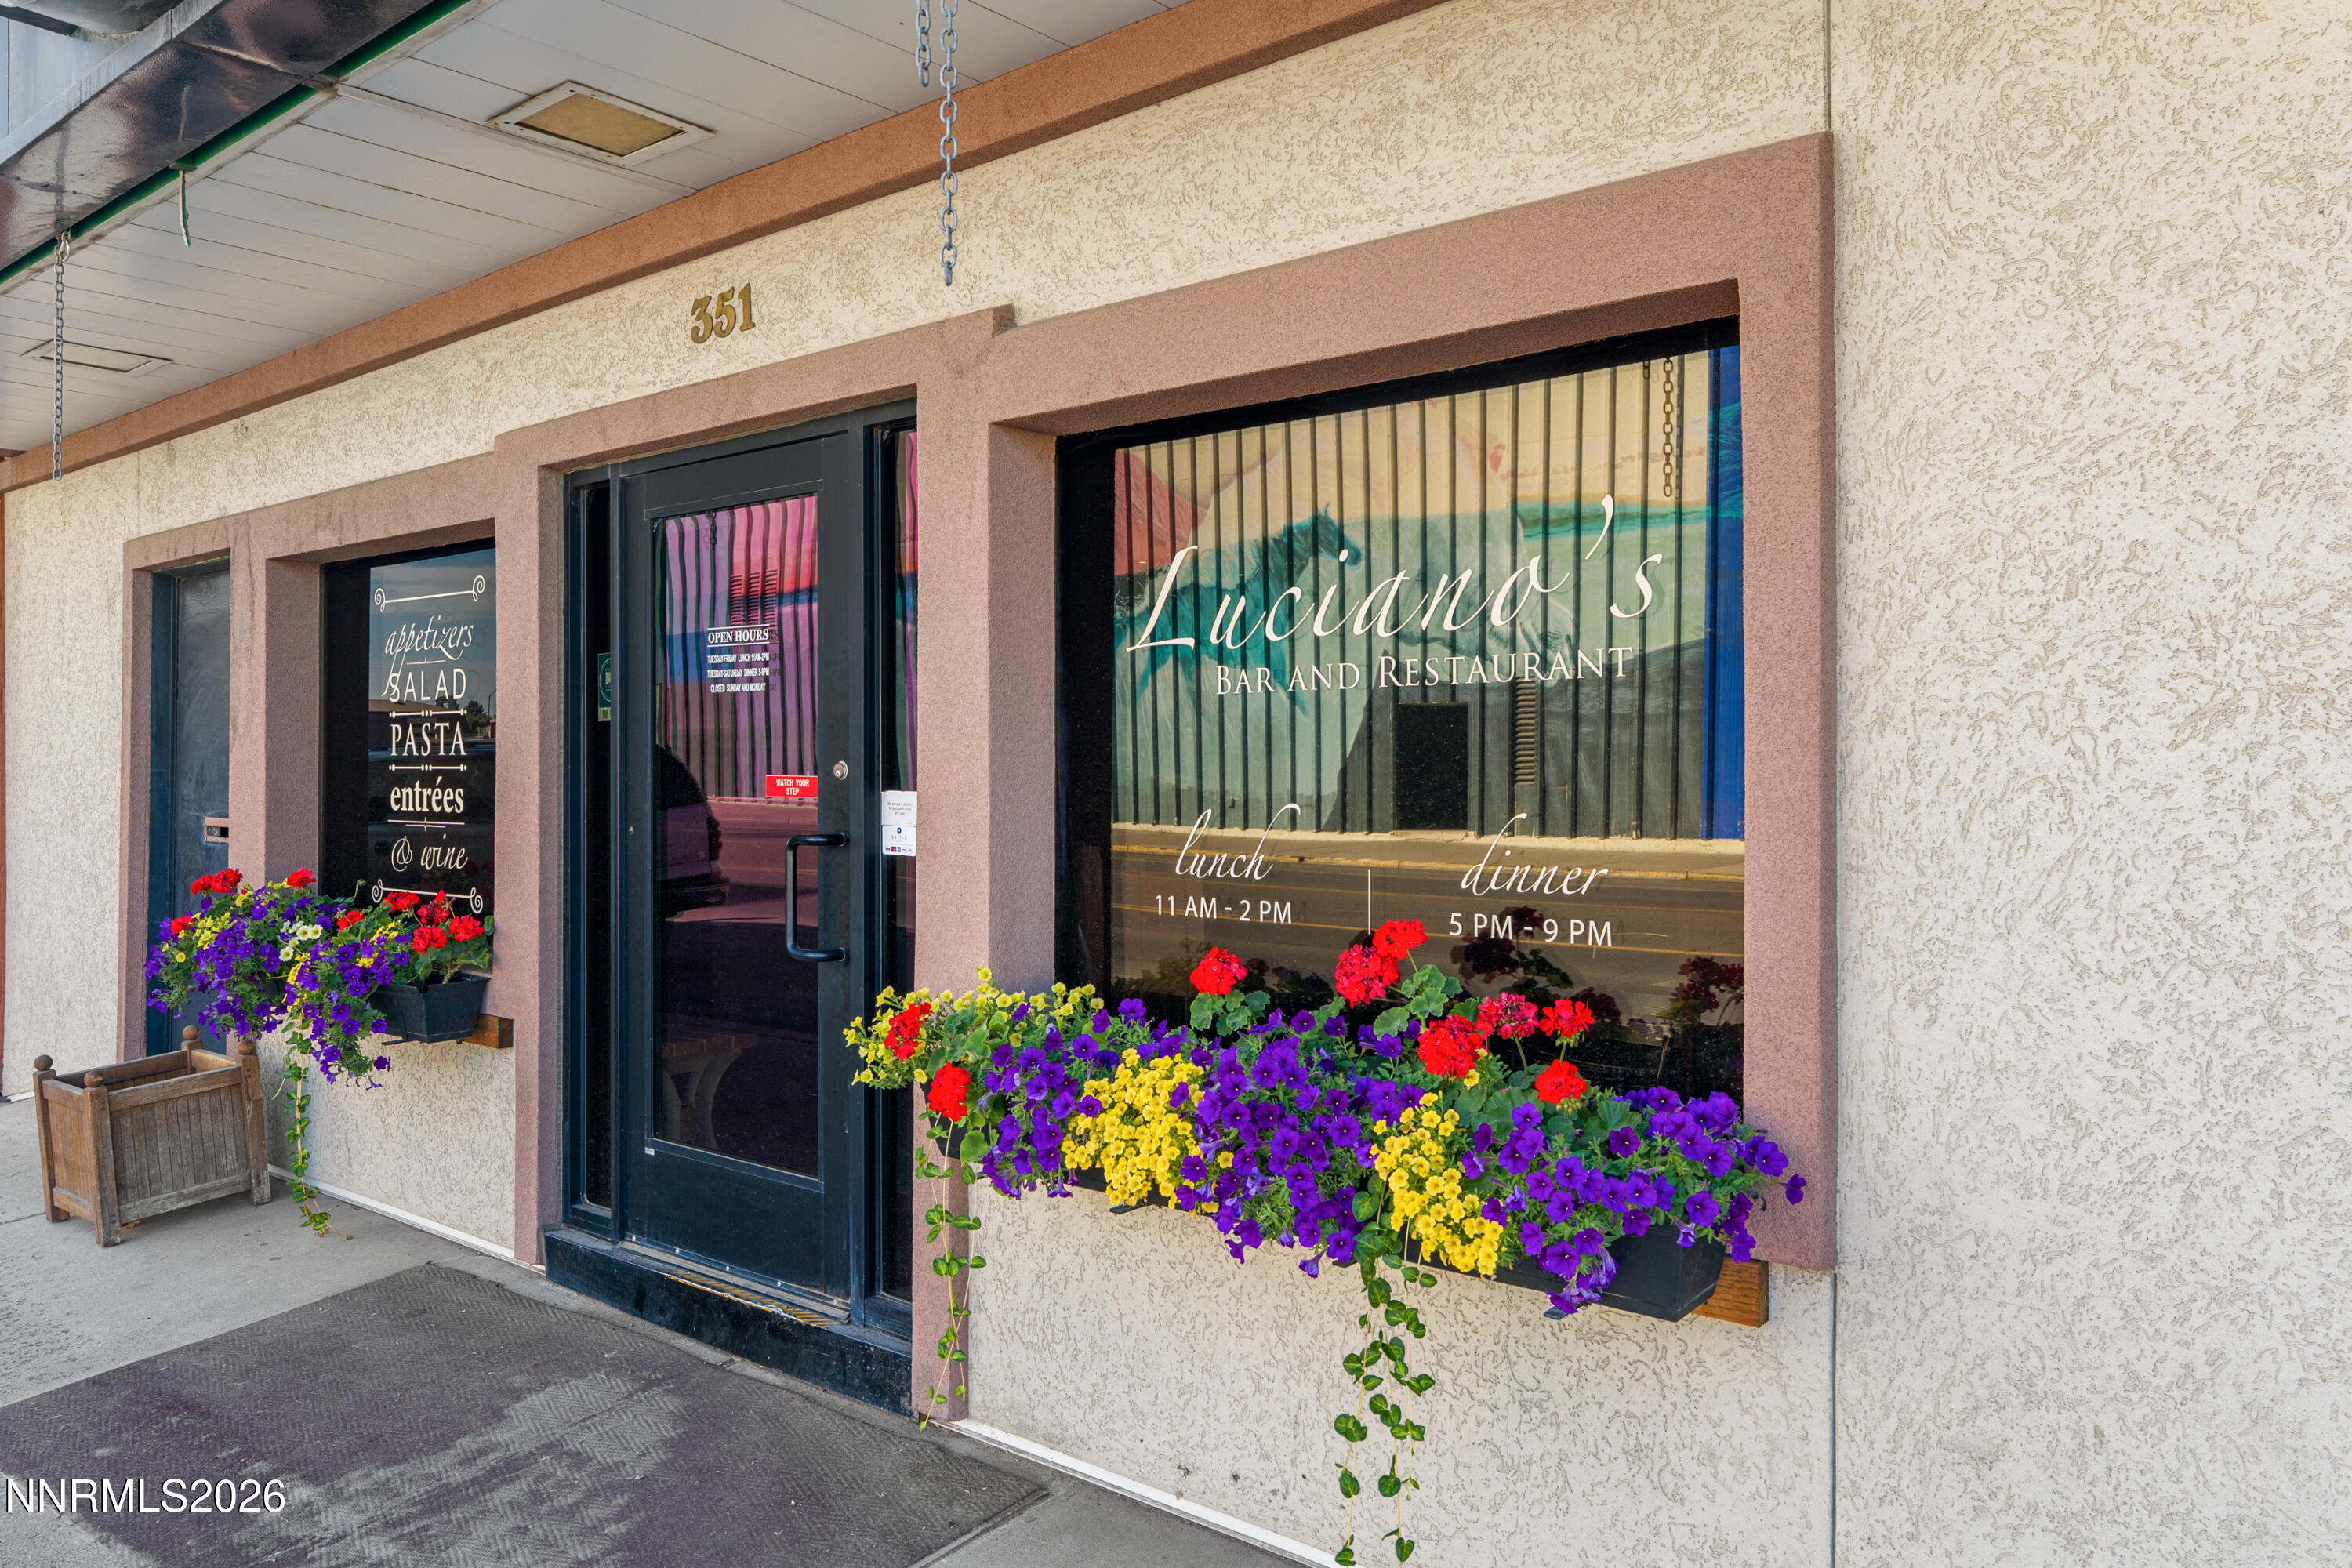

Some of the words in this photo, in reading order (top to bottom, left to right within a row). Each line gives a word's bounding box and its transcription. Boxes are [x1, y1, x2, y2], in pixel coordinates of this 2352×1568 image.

[691, 282, 756, 343] 351
[1126, 494, 1663, 652] Luciano's
[708, 630, 734, 644] OPEN
[735, 628, 769, 642] HOURS
[382, 615, 474, 697] appetizers
[707, 654, 737, 664] TUESDAY-FRIDAY
[738, 653, 751, 662] LUNCH
[707, 668, 743, 678] TUESDAY-SATURDAY
[743, 667, 758, 677] DINNER
[389, 667, 466, 702] SALAD
[710, 684, 726, 693] CLOSED
[726, 683, 741, 692] SUNDAY
[741, 683, 750, 692] AND
[750, 682, 766, 691] MONDAY
[390, 721, 466, 757] PASTA
[390, 776, 464, 814] entrées
[786, 787, 800, 796] STEP
[421, 833, 469, 870] wine
[1175, 803, 1301, 880] lunch
[1461, 813, 1609, 896] dinner
[1155, 895, 1174, 916] 11
[1185, 896, 1218, 920] AM
[1240, 899, 1251, 921] 2
[1259, 900, 1292, 924] PM
[1450, 913, 1462, 936] 5
[1474, 913, 1513, 940] PM
[1543, 918, 1558, 943] 9
[1570, 920, 1613, 947] PM
